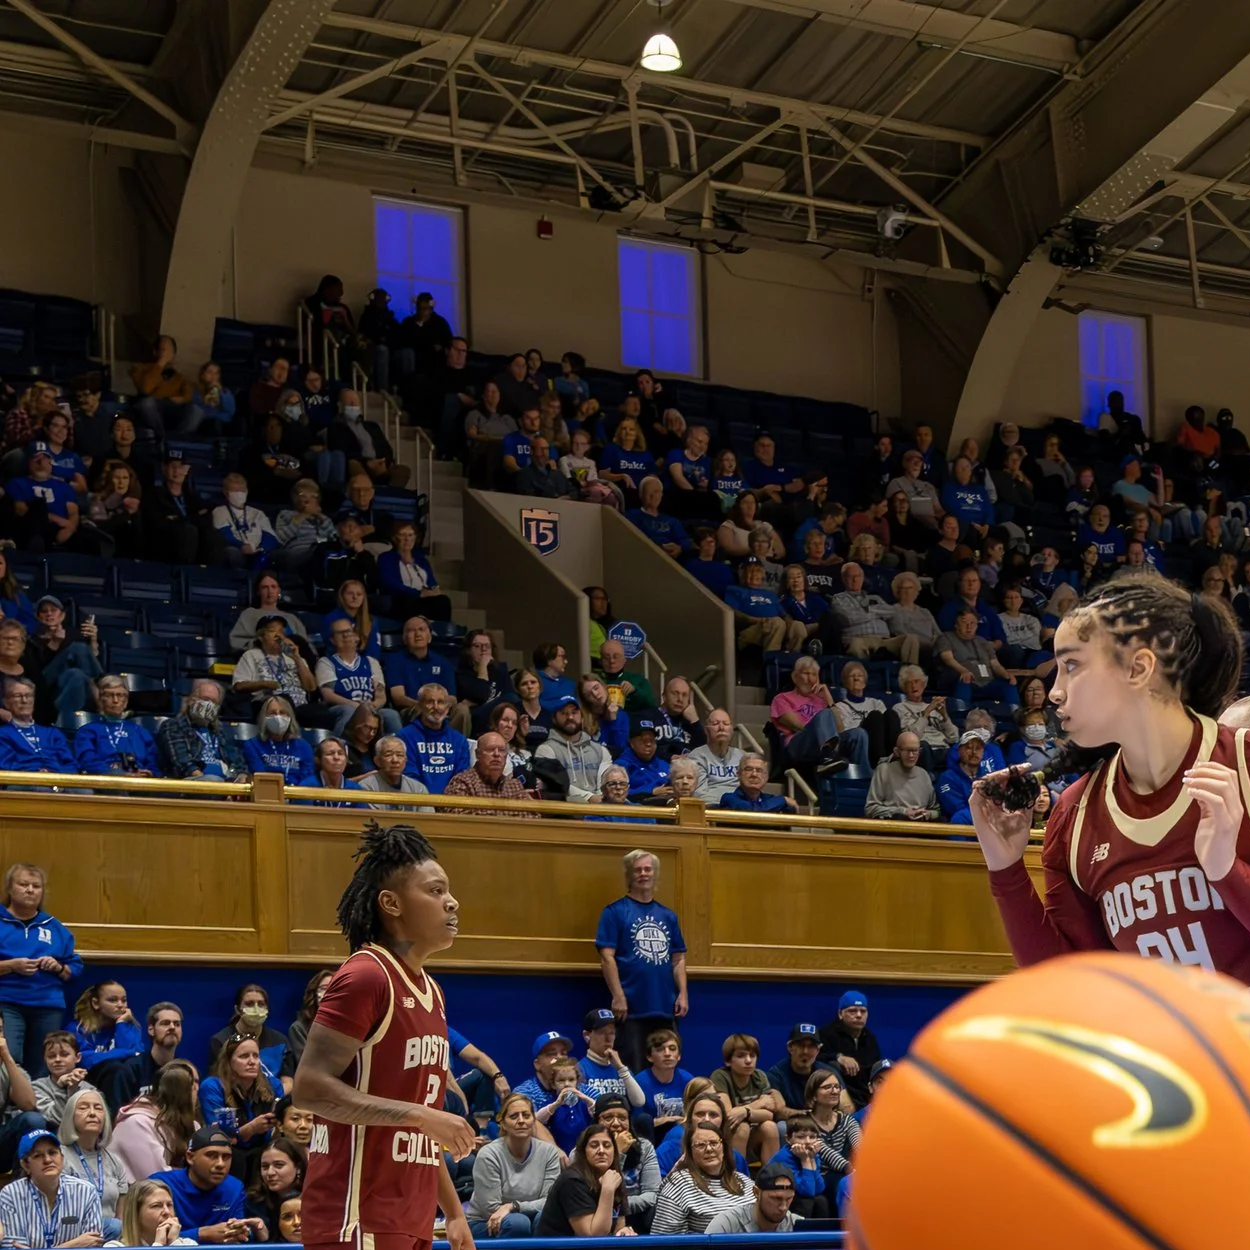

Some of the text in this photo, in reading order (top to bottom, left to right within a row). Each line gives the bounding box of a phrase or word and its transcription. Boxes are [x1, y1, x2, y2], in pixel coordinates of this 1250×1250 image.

[528, 521, 553, 546] 15
[340, 676, 374, 692] DUKE
[417, 741, 454, 754] DUKE
[709, 763, 740, 778] DUK
[403, 1034, 450, 1071] BOSTO
[425, 1073, 441, 1107] 2
[588, 1078, 625, 1087] CAMERO
[392, 1131, 440, 1167] COLLE
